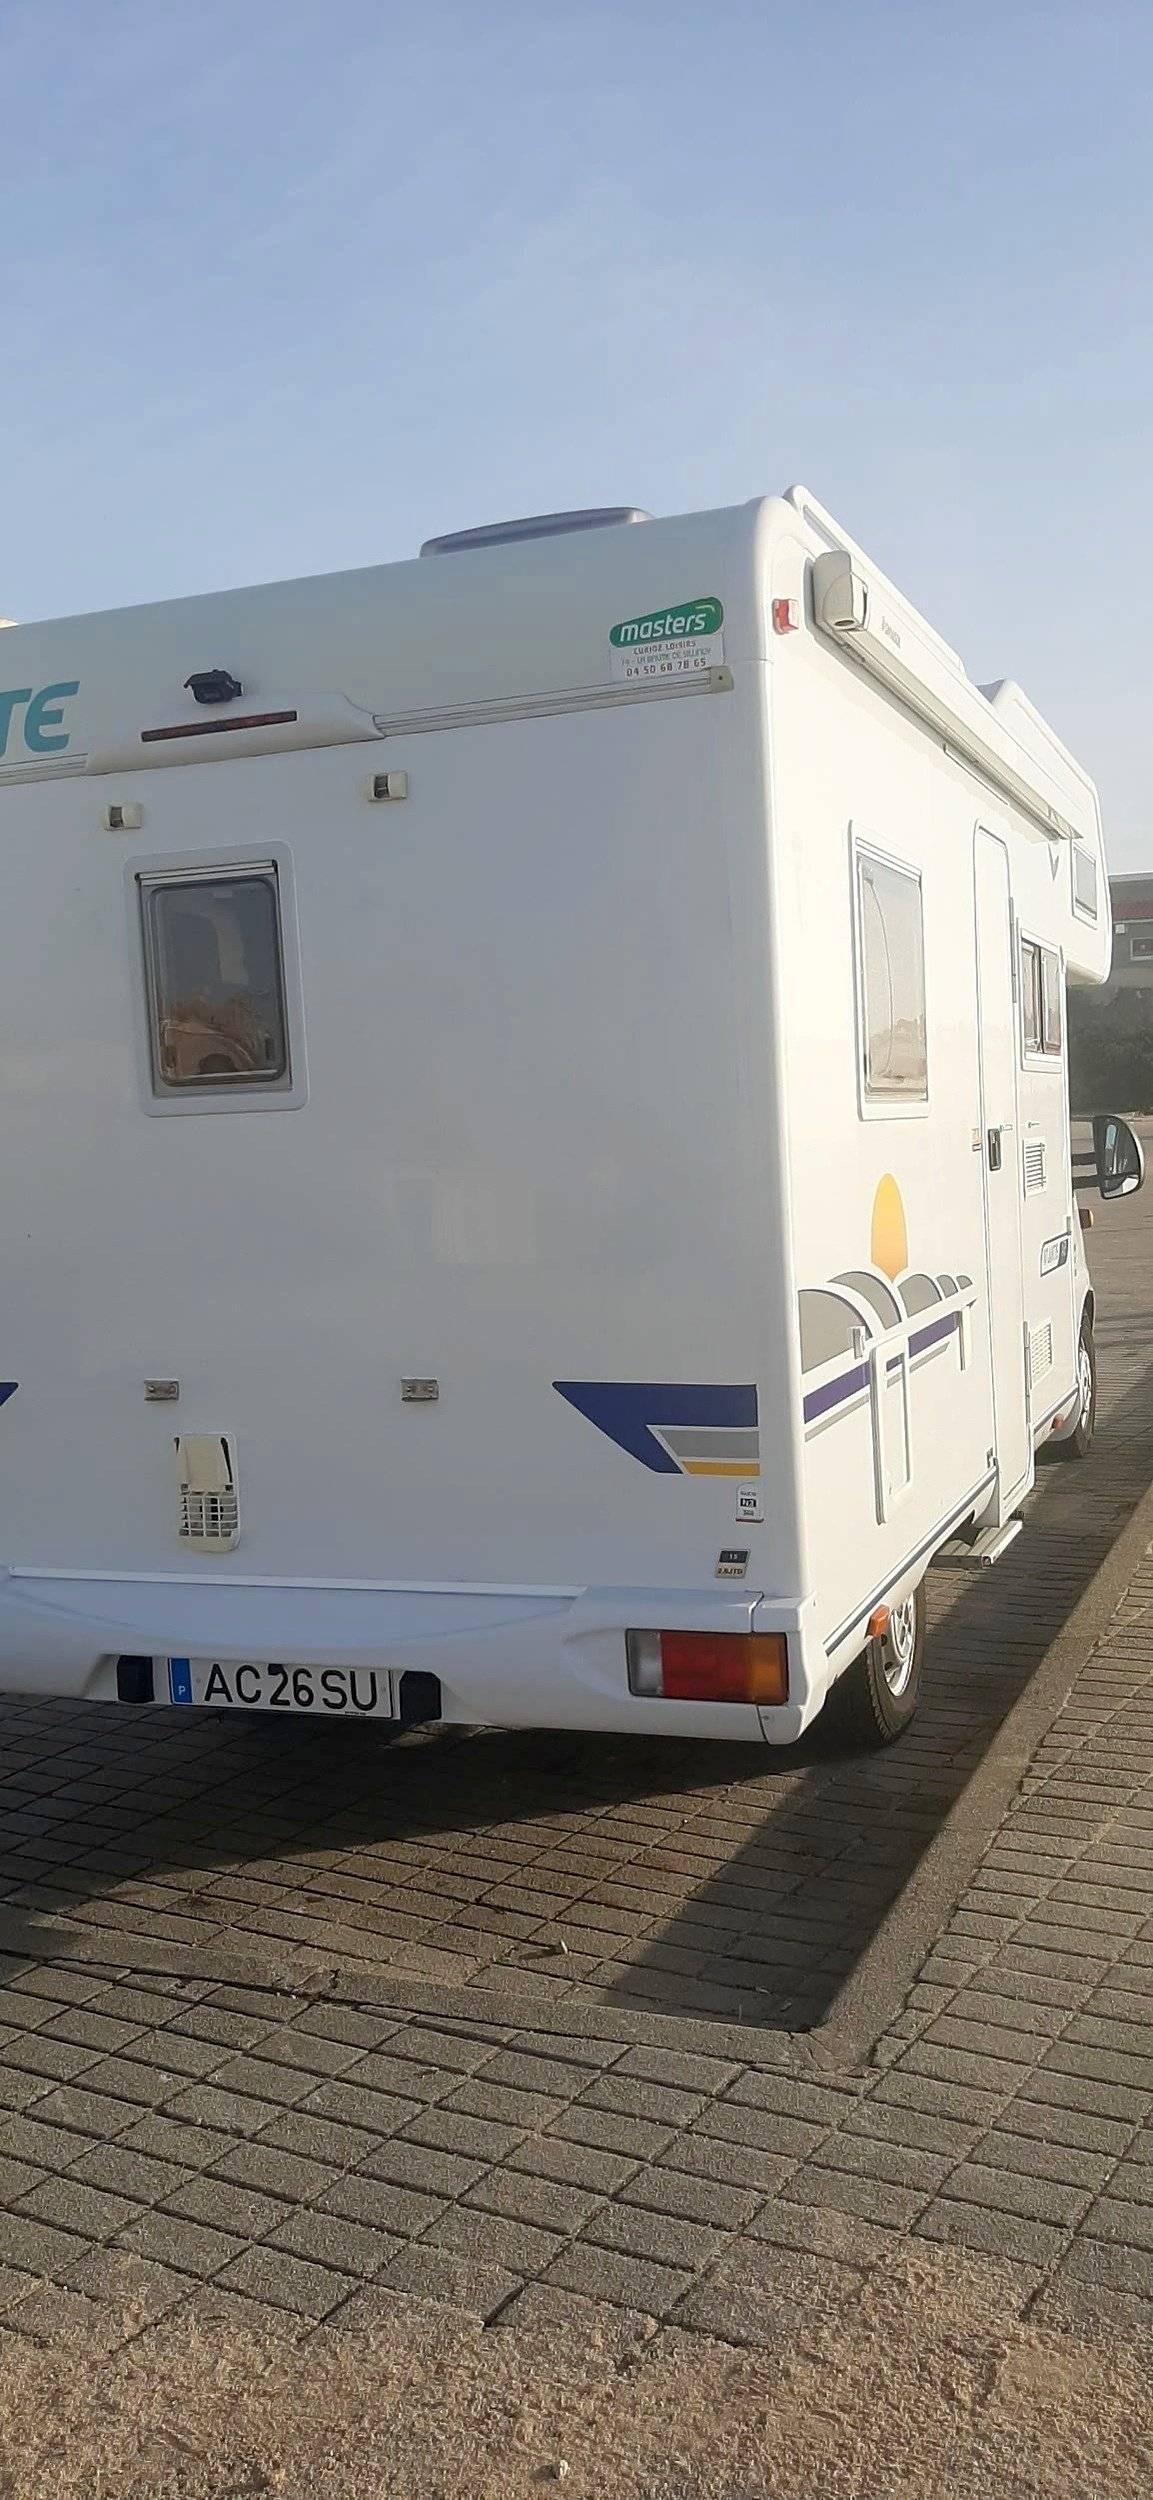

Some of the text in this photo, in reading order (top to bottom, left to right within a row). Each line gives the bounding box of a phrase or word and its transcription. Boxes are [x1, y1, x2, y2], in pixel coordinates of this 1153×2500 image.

[620, 613, 706, 642] masters
[626, 667, 639, 677] 04
[643, 665, 656, 674] 50
[693, 658, 706, 667] 65
[177, 1685, 186, 1696] P
